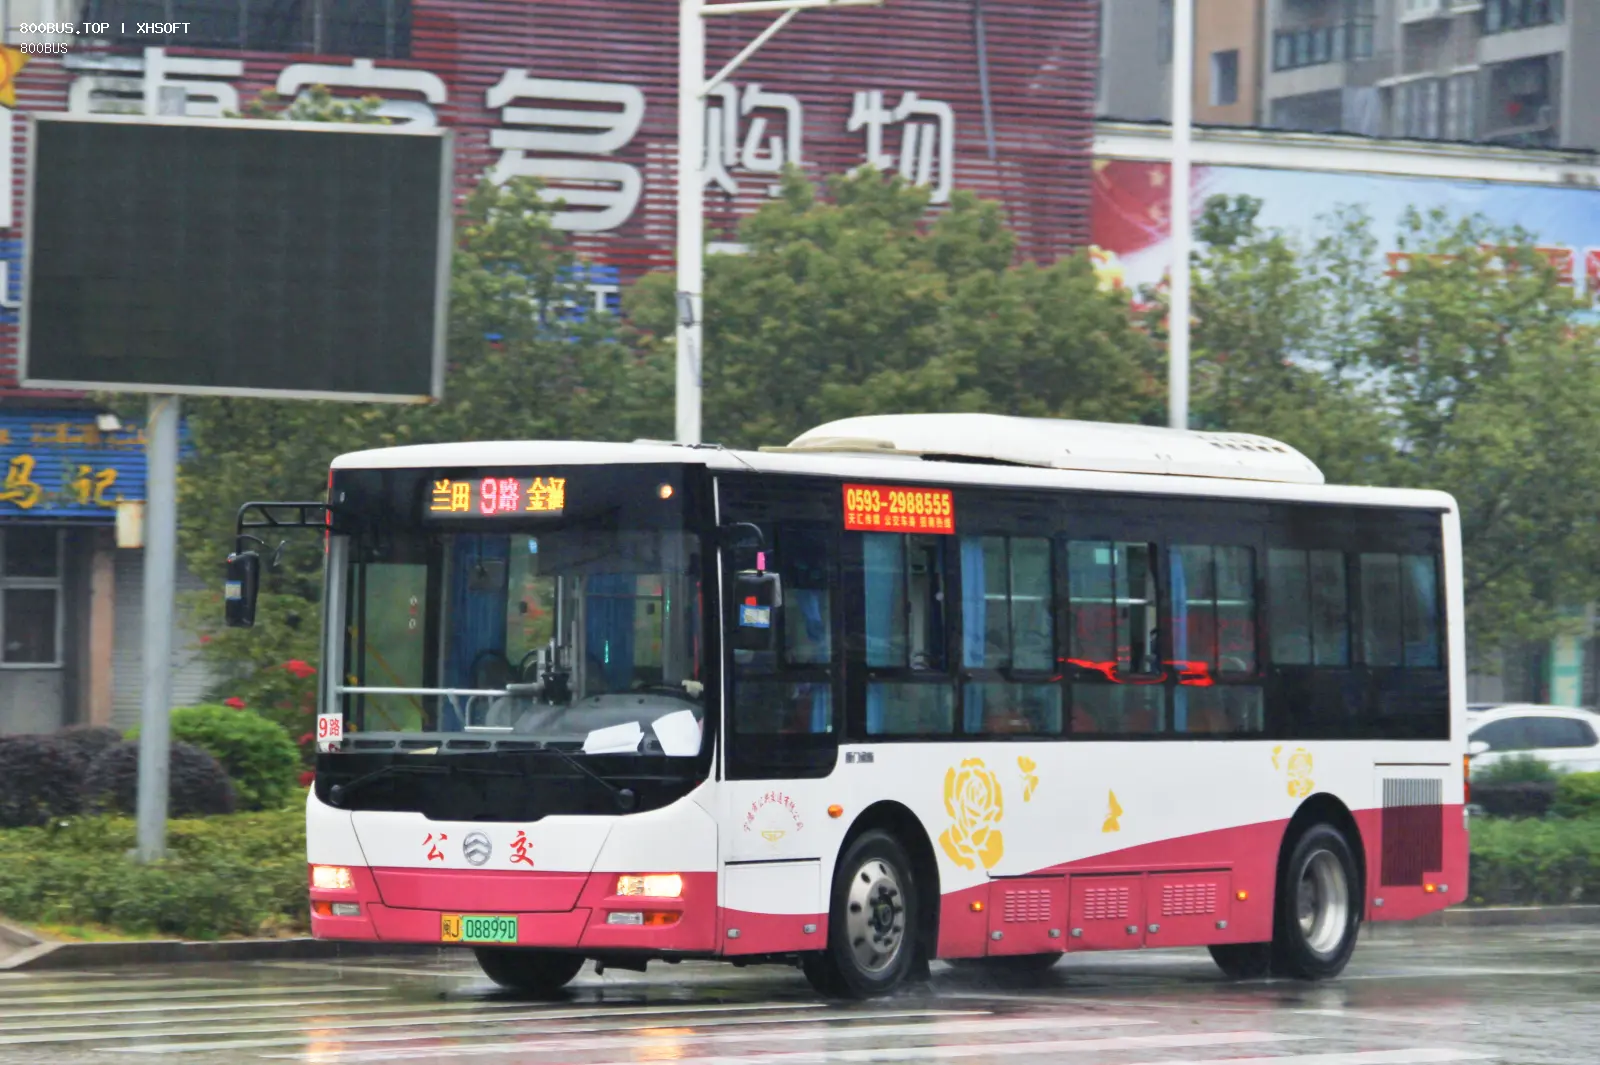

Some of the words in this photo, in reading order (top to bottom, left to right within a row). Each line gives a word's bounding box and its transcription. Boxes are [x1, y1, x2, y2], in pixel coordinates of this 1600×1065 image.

[430, 478, 470, 511] 兰田
[480, 477, 519, 515] 9路
[847, 488, 951, 516] 0593-2988555
[319, 717, 340, 738] 9路
[422, 832, 448, 861] 公
[509, 830, 535, 867] 交
